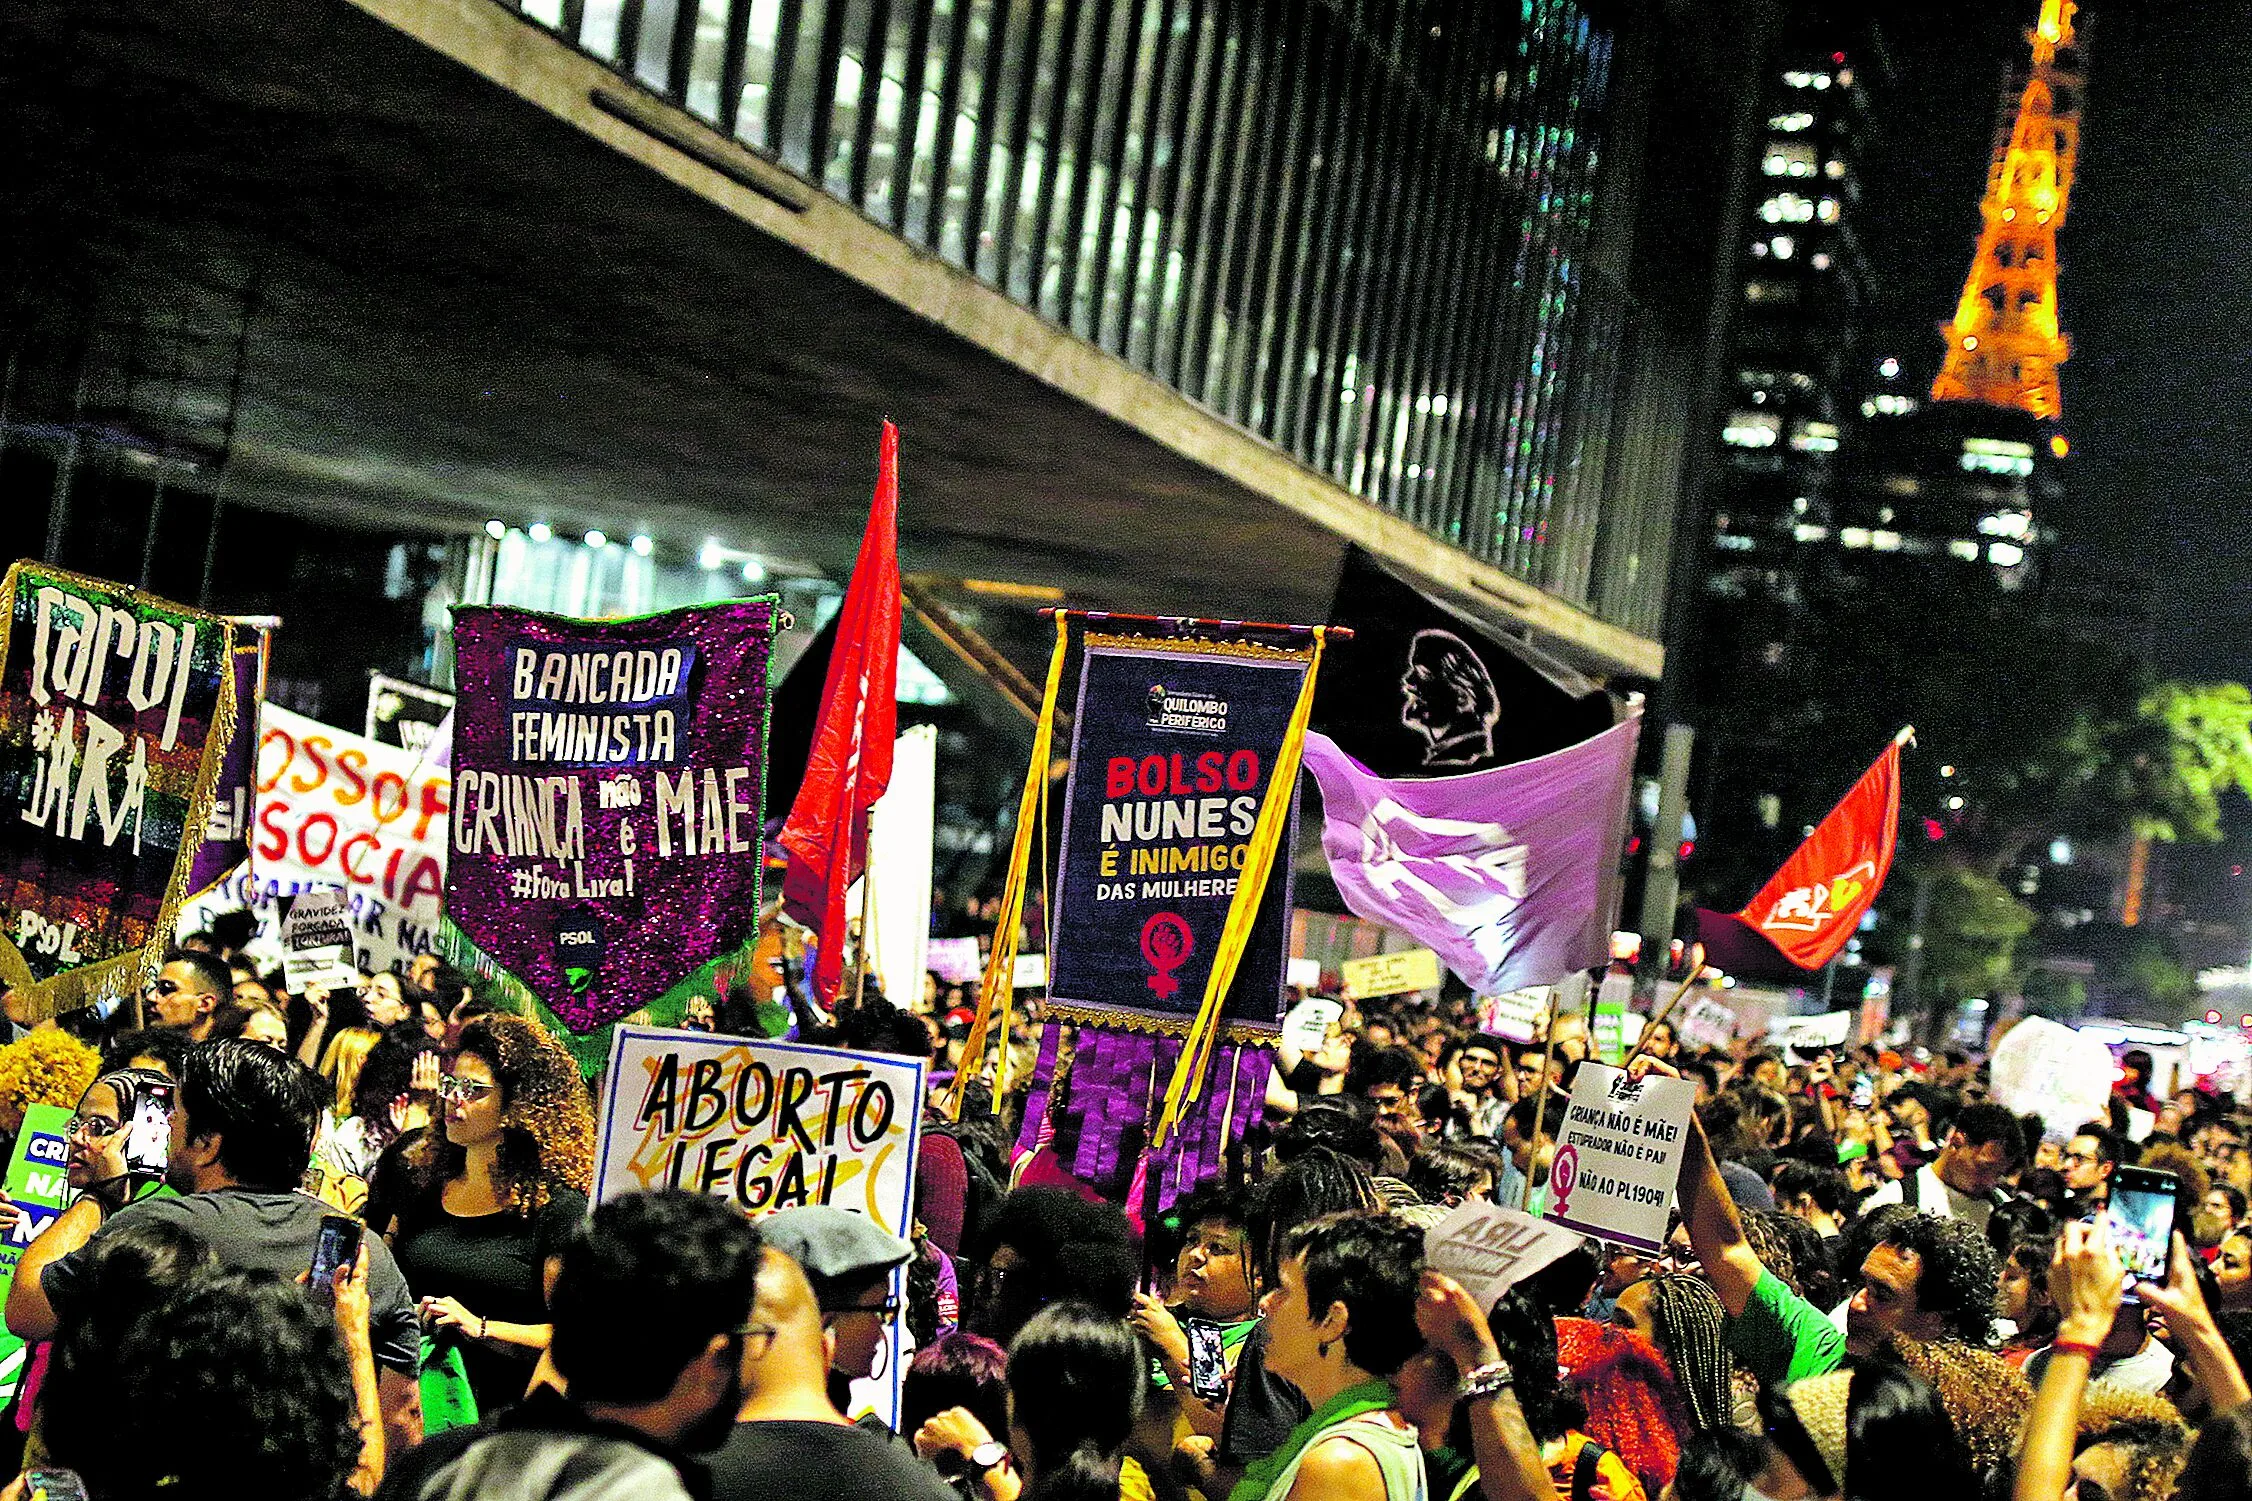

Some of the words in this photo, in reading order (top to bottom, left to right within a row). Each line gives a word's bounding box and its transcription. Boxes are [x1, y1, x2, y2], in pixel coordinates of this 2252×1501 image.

[513, 647, 682, 704] BANCADA
[1161, 712, 1226, 730] PERIFÉRICO
[1163, 697, 1228, 716] QUILOMBO
[512, 710, 676, 763] FEMINISTA
[1106, 750, 1260, 799] BOLSO
[454, 769, 585, 869] CRIANÇA
[599, 774, 642, 809] não
[654, 766, 751, 857] MÃE
[1101, 796, 1257, 843] NUNES
[1100, 843, 1120, 877] É
[1130, 844, 1250, 876] INIMIGO
[1096, 882, 1136, 901] DAS
[1142, 878, 1239, 900] MULHERE
[17, 909, 81, 963] PSOL
[559, 931, 597, 947] PSOL
[640, 1052, 896, 1155] ABORTO
[1569, 1105, 1606, 1129] CRIANÇA
[1607, 1110, 1631, 1133] NÃO
[1632, 1115, 1643, 1136] É
[1644, 1118, 1678, 1143] MÃE!
[1613, 1139, 1634, 1158] NÃO
[1636, 1143, 1644, 1160] É
[1579, 1169, 1598, 1192] NÃO
[1598, 1176, 1615, 1196] AO
